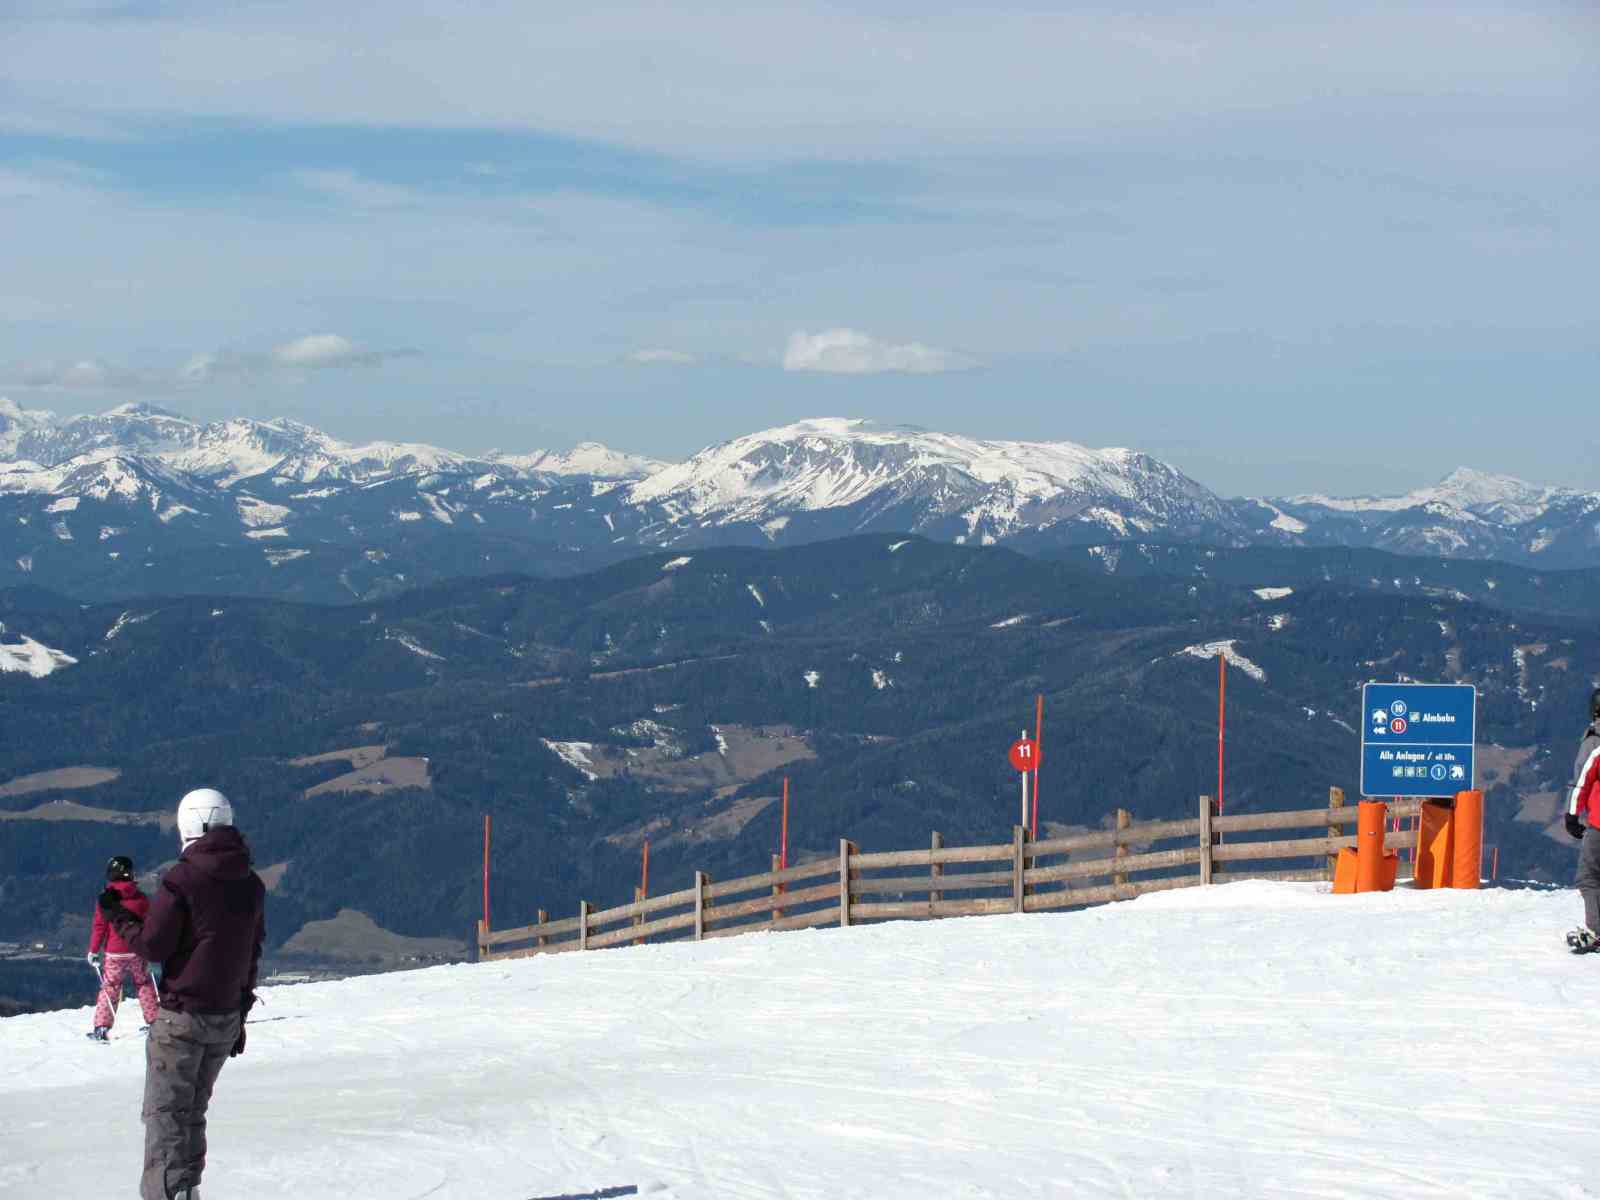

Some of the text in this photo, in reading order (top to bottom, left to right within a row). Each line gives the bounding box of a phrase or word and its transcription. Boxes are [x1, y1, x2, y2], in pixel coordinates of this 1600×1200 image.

[1395, 704, 1403, 713] 10
[1422, 712, 1455, 722] Almbahn
[1395, 721, 1402, 730] 11
[1017, 744, 1030, 758] 11
[1380, 751, 1393, 760] Alle
[1396, 751, 1424, 762] Anlagen
